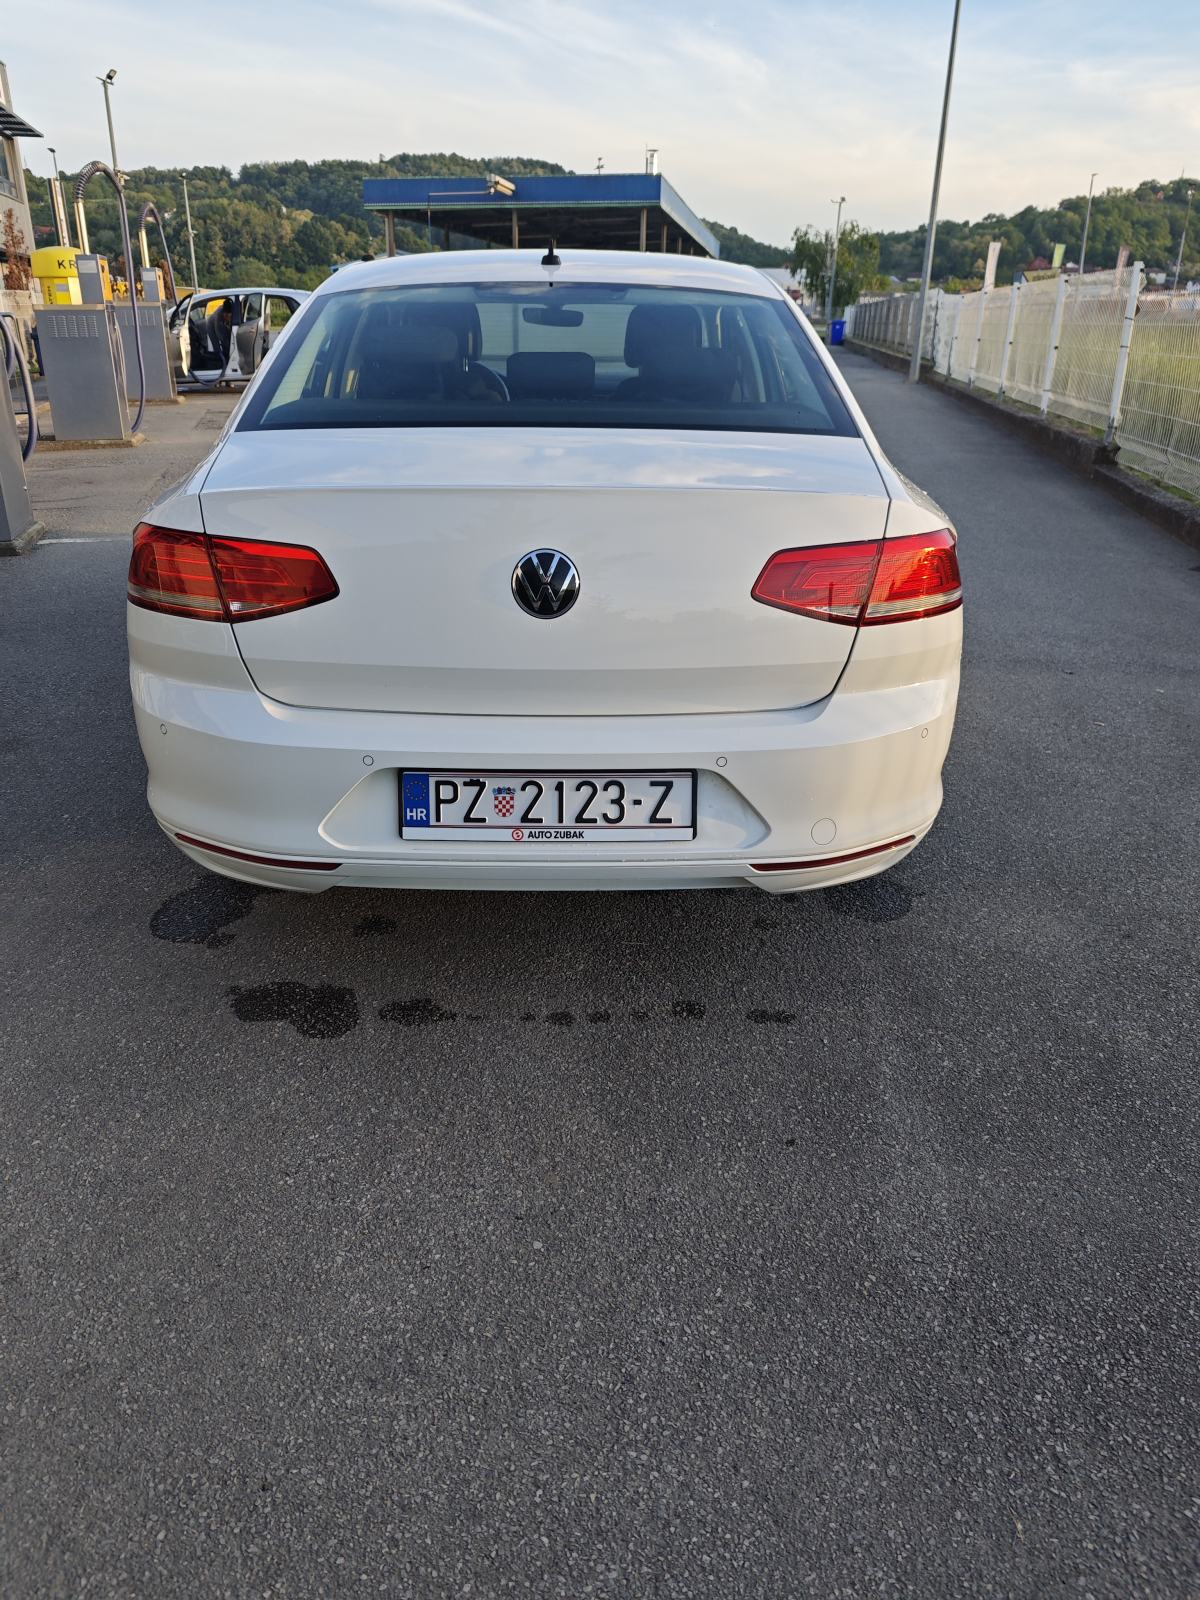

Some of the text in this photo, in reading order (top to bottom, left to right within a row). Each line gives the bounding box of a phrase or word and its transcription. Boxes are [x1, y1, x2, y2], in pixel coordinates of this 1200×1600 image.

[513, 550, 578, 616] VW
[406, 807, 427, 821] HR
[520, 780, 674, 824] 2123-Z
[527, 830, 585, 839] AUTO ZUBAK
